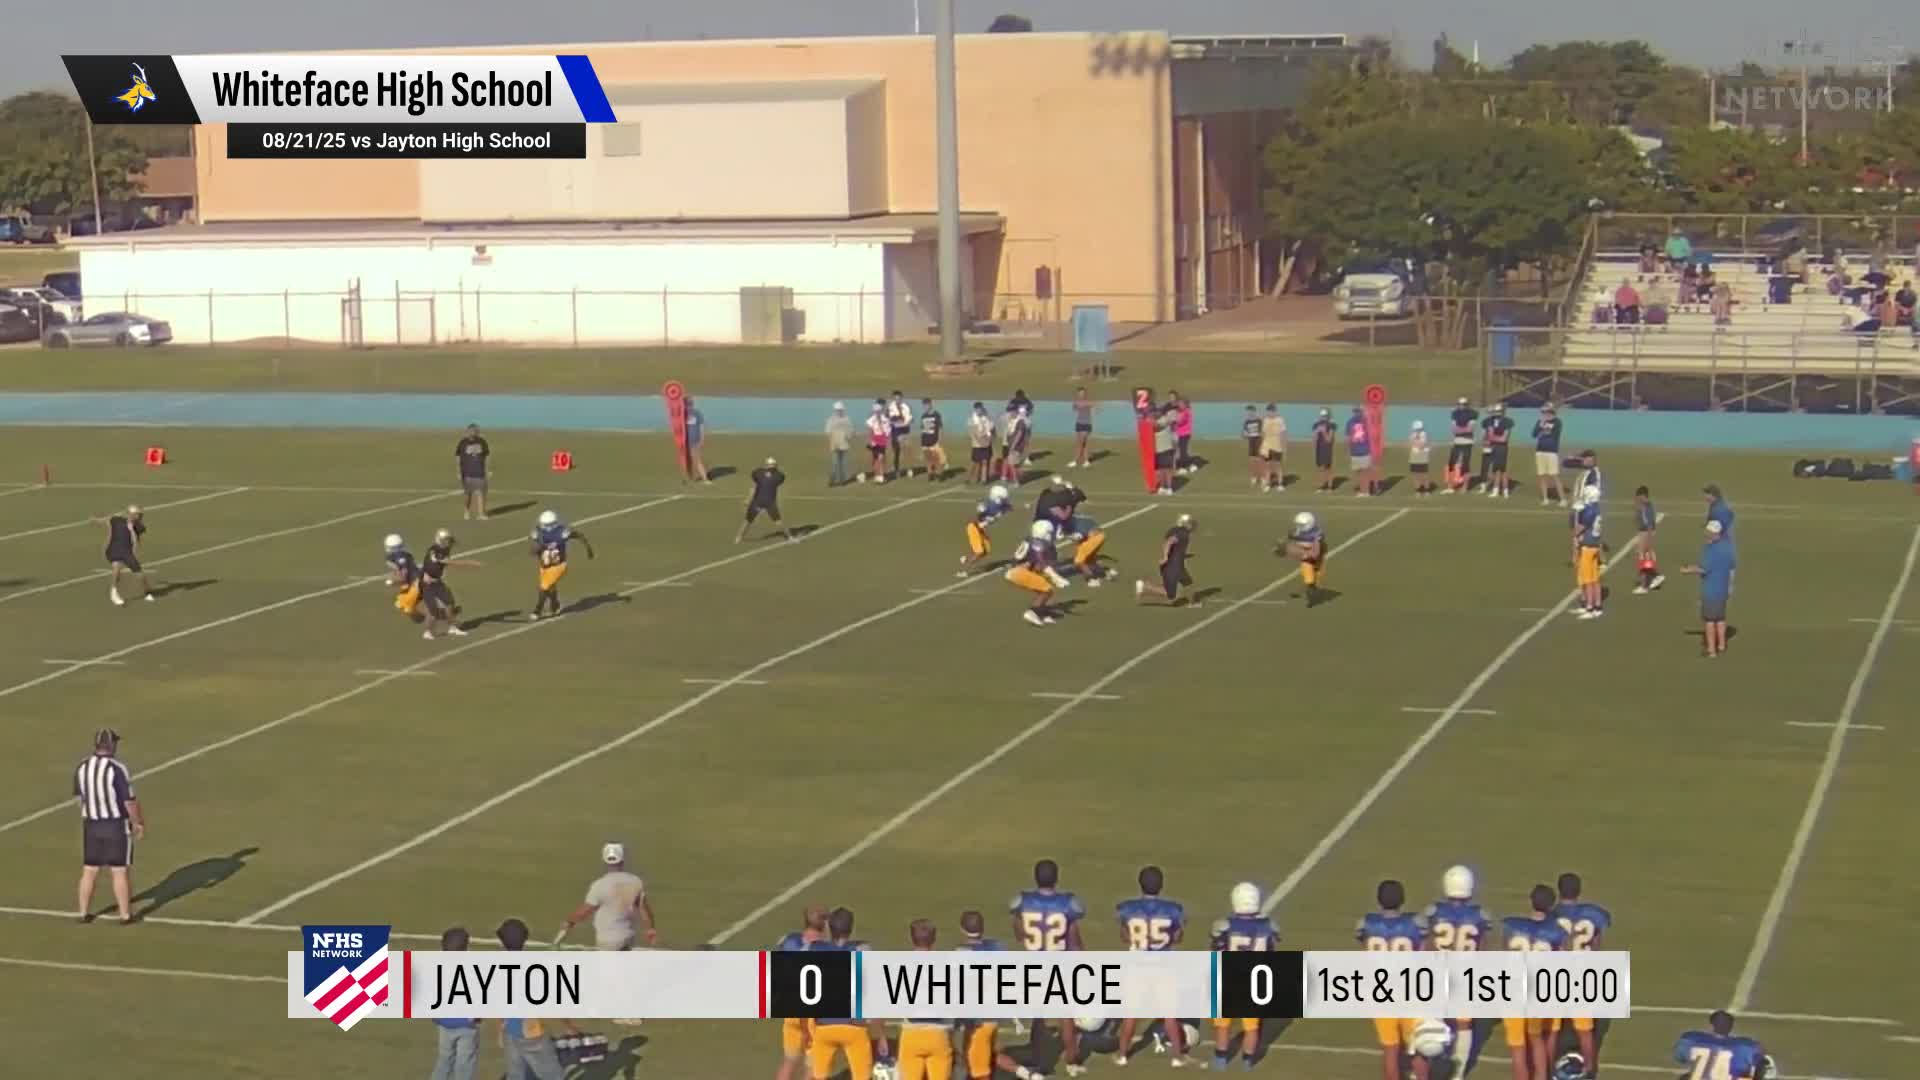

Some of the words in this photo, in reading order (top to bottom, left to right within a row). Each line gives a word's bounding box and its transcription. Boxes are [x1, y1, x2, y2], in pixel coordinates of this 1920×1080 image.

[1136, 389, 1150, 409] 2
[1021, 911, 1068, 950] 52
[1127, 917, 1173, 950] 85
[1432, 921, 1479, 950] 26
[1690, 1047, 1733, 1080] 74
